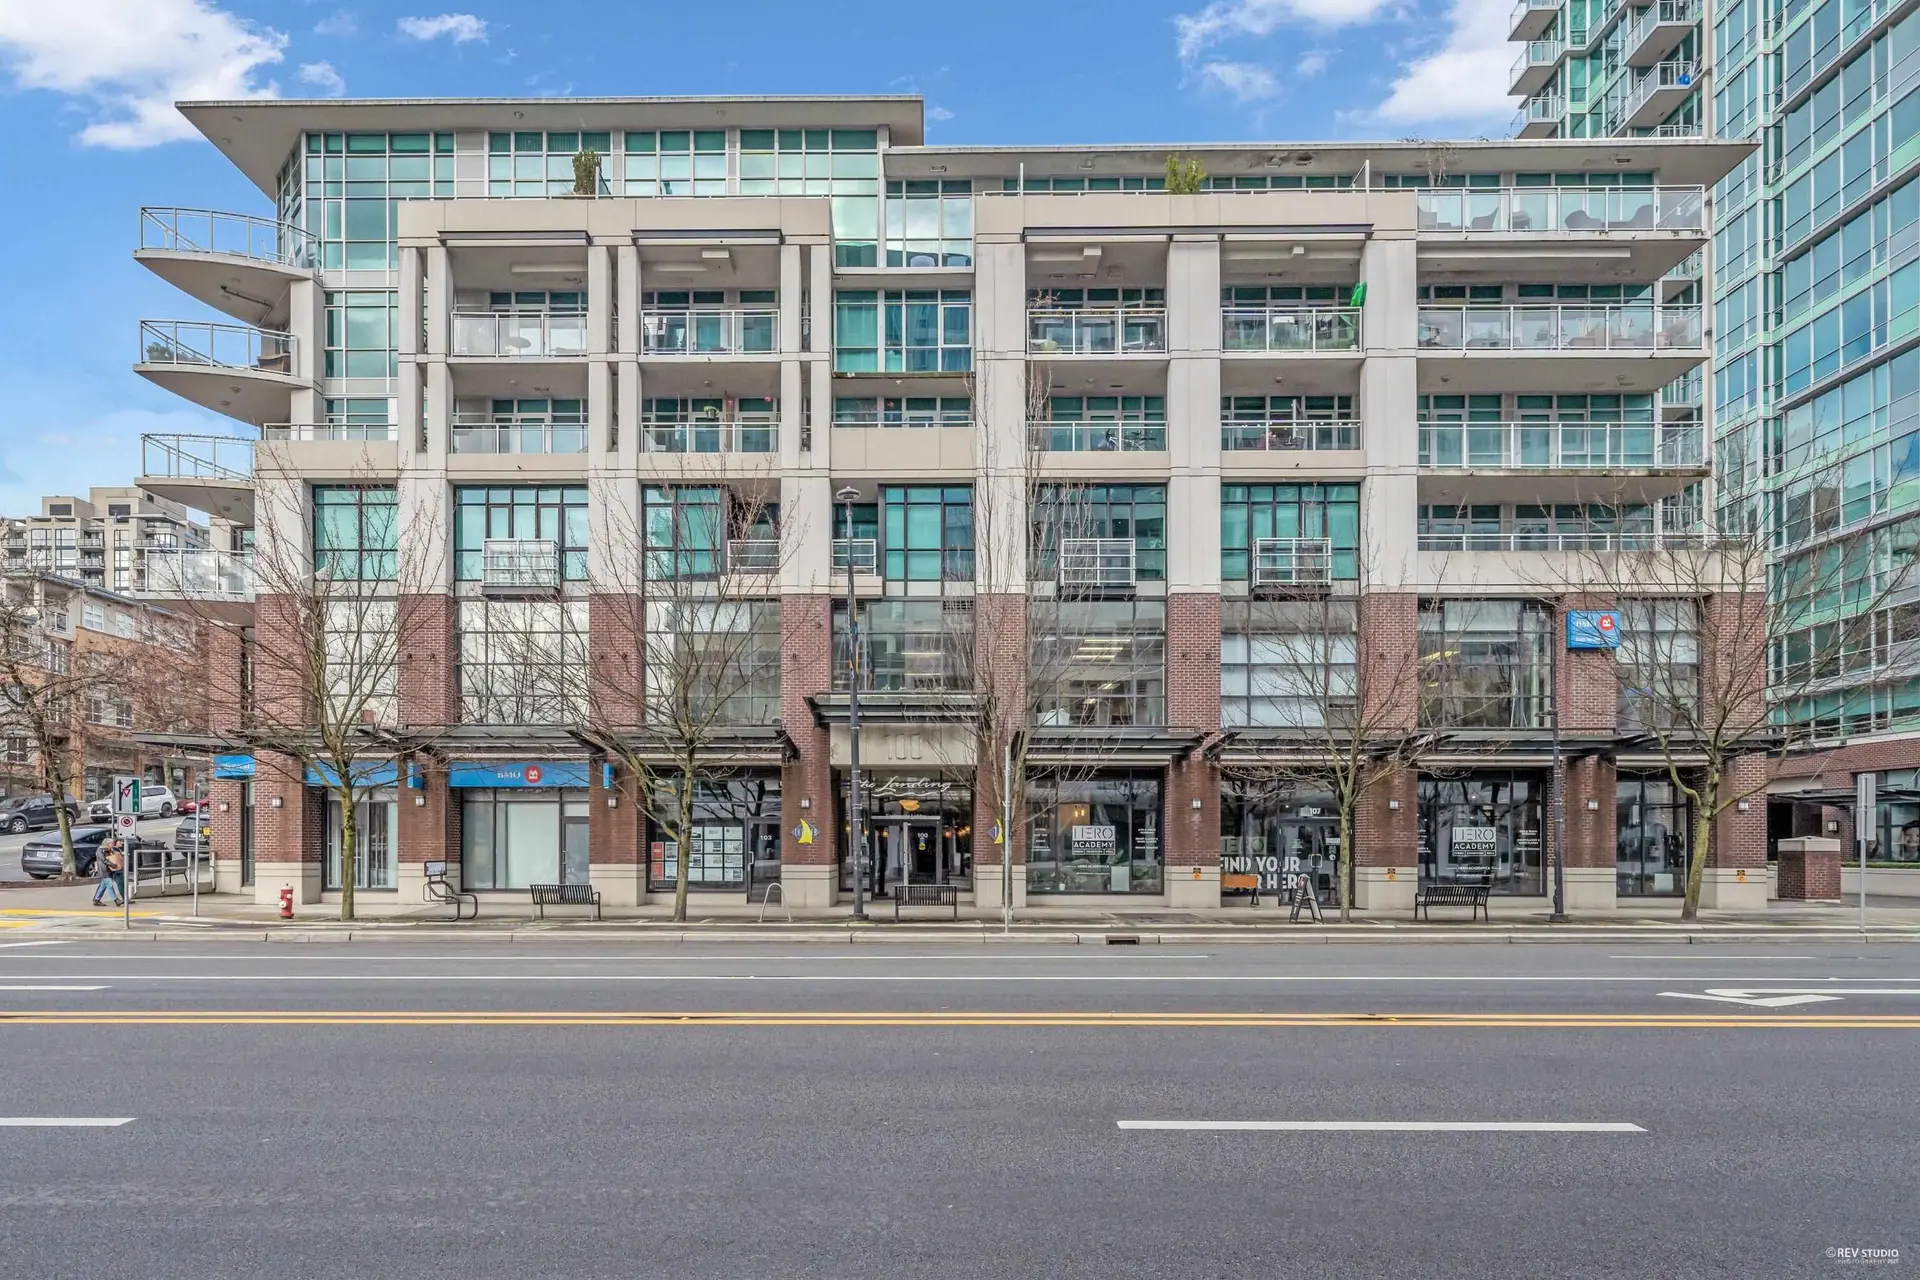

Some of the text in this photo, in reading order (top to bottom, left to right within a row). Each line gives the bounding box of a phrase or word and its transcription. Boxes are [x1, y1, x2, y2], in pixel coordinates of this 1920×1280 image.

[884, 733, 923, 760] 100
[497, 770, 521, 779] BMO
[875, 775, 952, 792] Landing
[1074, 827, 1114, 839] HERO
[1454, 828, 1494, 841] HERO
[1255, 856, 1300, 872] YOUR
